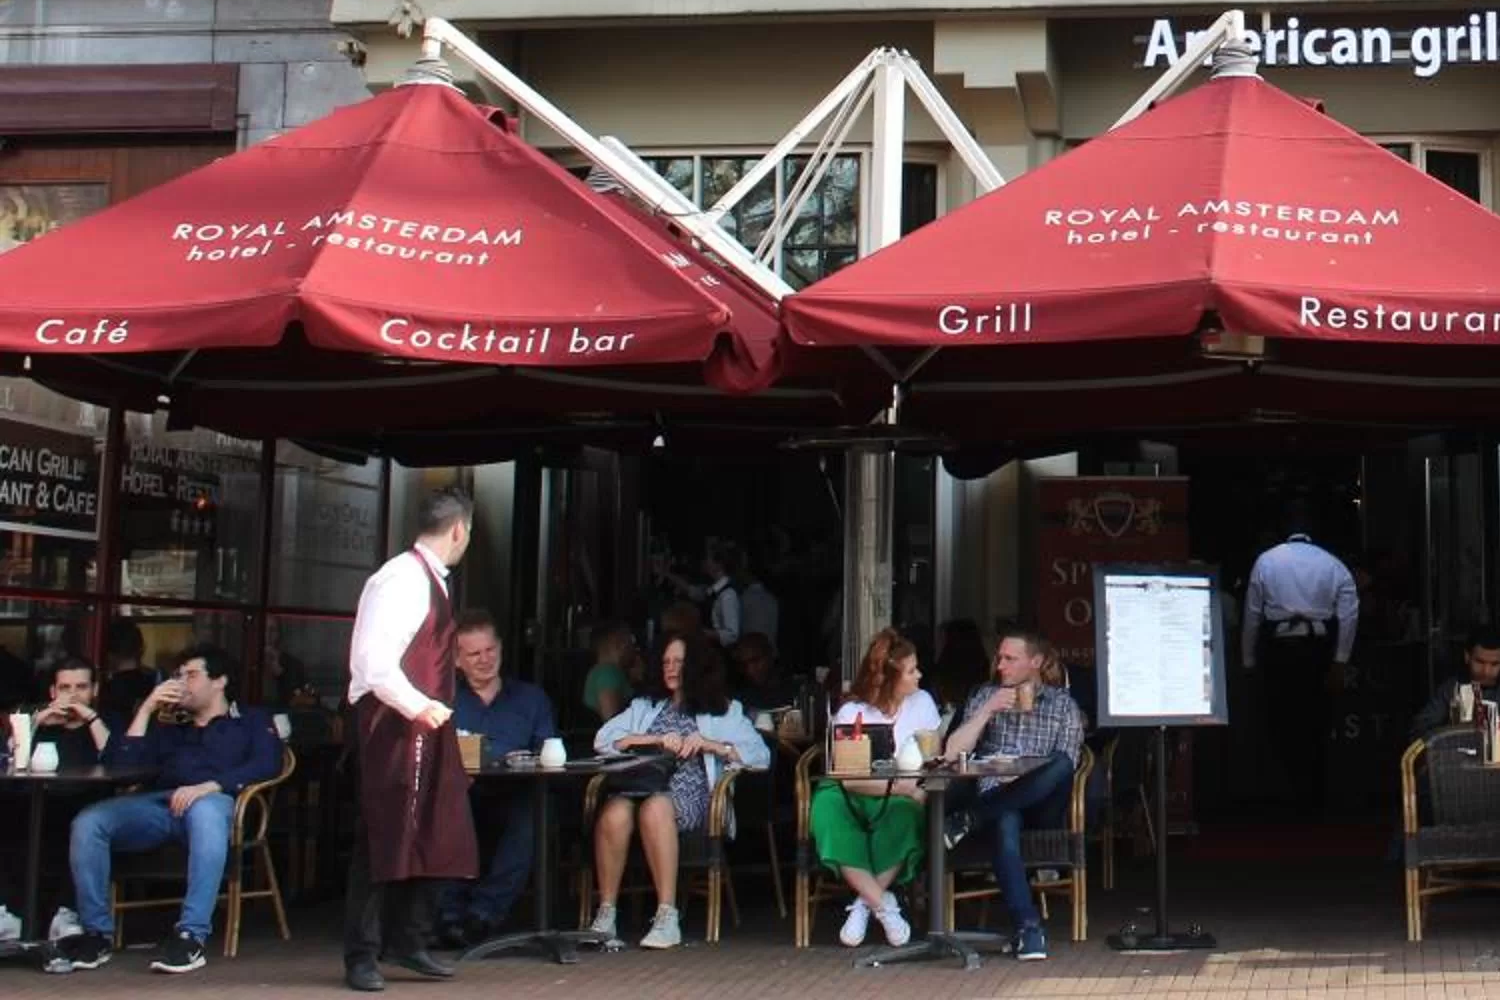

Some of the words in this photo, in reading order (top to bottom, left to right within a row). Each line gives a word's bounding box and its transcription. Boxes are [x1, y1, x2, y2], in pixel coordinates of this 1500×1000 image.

[172, 221, 286, 241] ROYAL
[300, 210, 523, 246] AMSTERDAM
[1044, 206, 1160, 225] ROYAL
[1177, 200, 1400, 226] AMSTERDAM
[1067, 224, 1151, 245] hotel
[1197, 220, 1373, 245] restaurant
[186, 240, 272, 261] hotel
[311, 232, 490, 266] restaurant
[35, 318, 129, 345] Café
[938, 302, 1033, 335] Grill
[379, 318, 551, 354] Cocktail
[568, 328, 634, 353] bar
[36, 480, 50, 509] &
